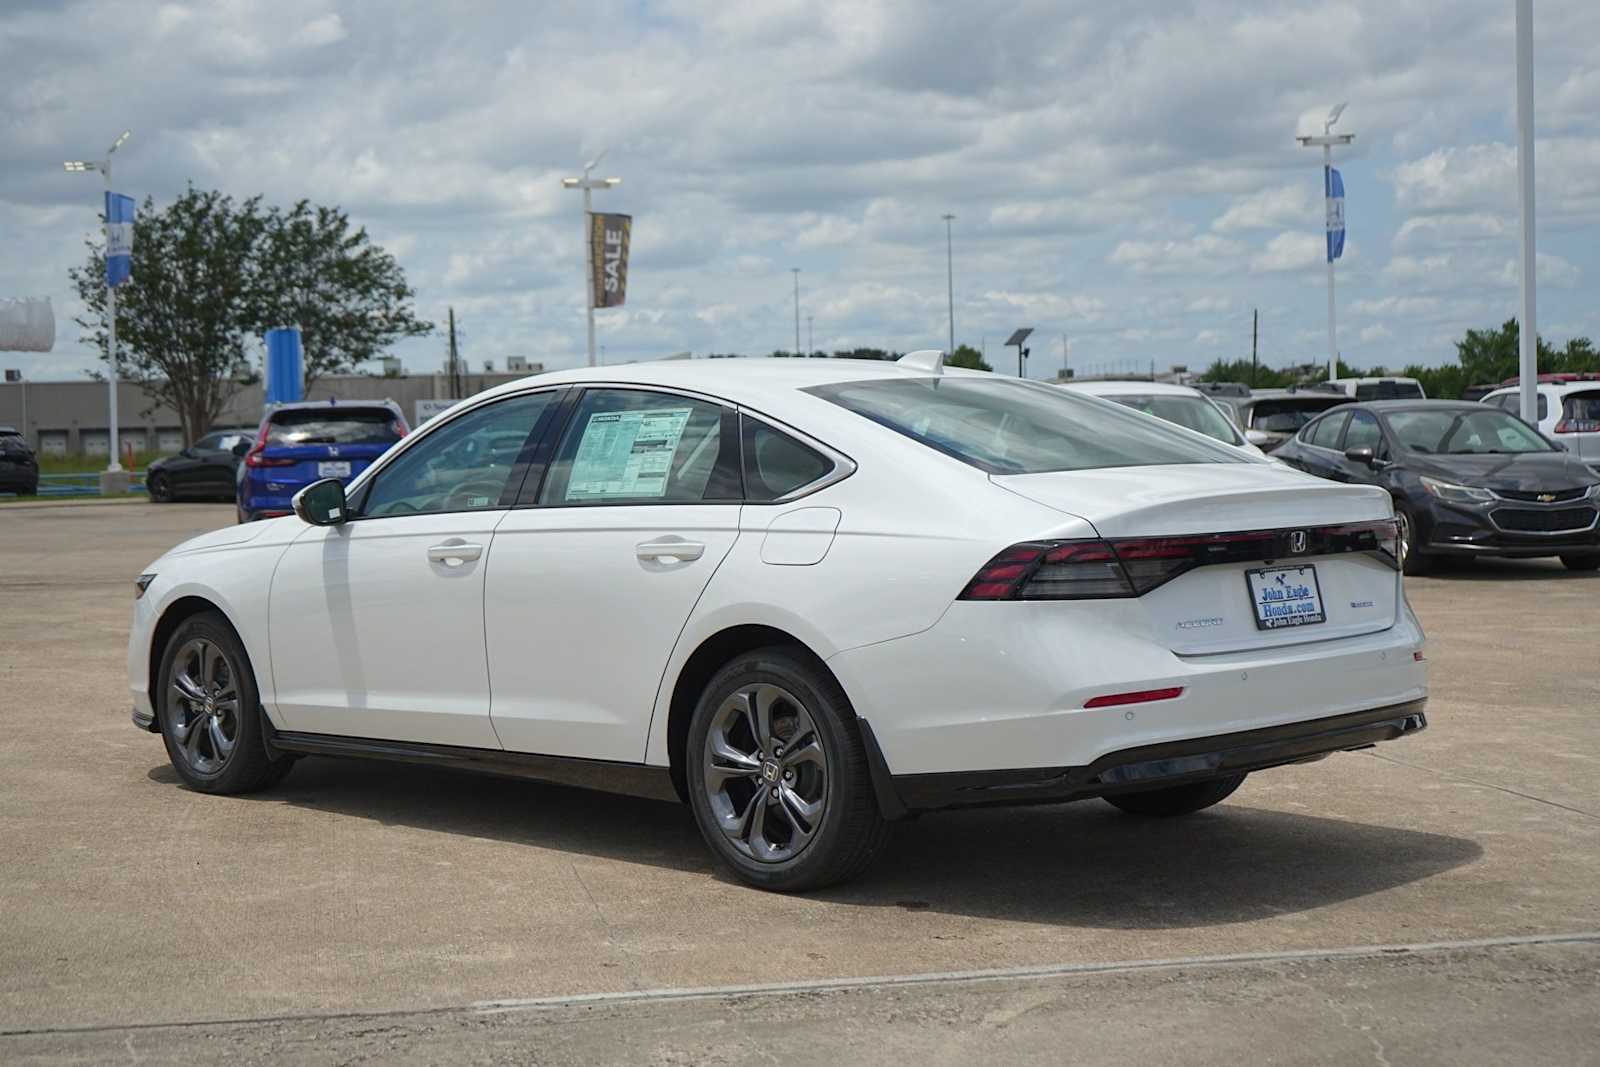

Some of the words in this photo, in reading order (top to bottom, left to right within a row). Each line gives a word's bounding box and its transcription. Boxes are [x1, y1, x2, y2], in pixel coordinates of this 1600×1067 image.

[604, 229, 622, 293] SALE
[1262, 587, 1284, 601] John
[1285, 585, 1310, 600] Eagle
[1263, 602, 1315, 617] Honda.com
